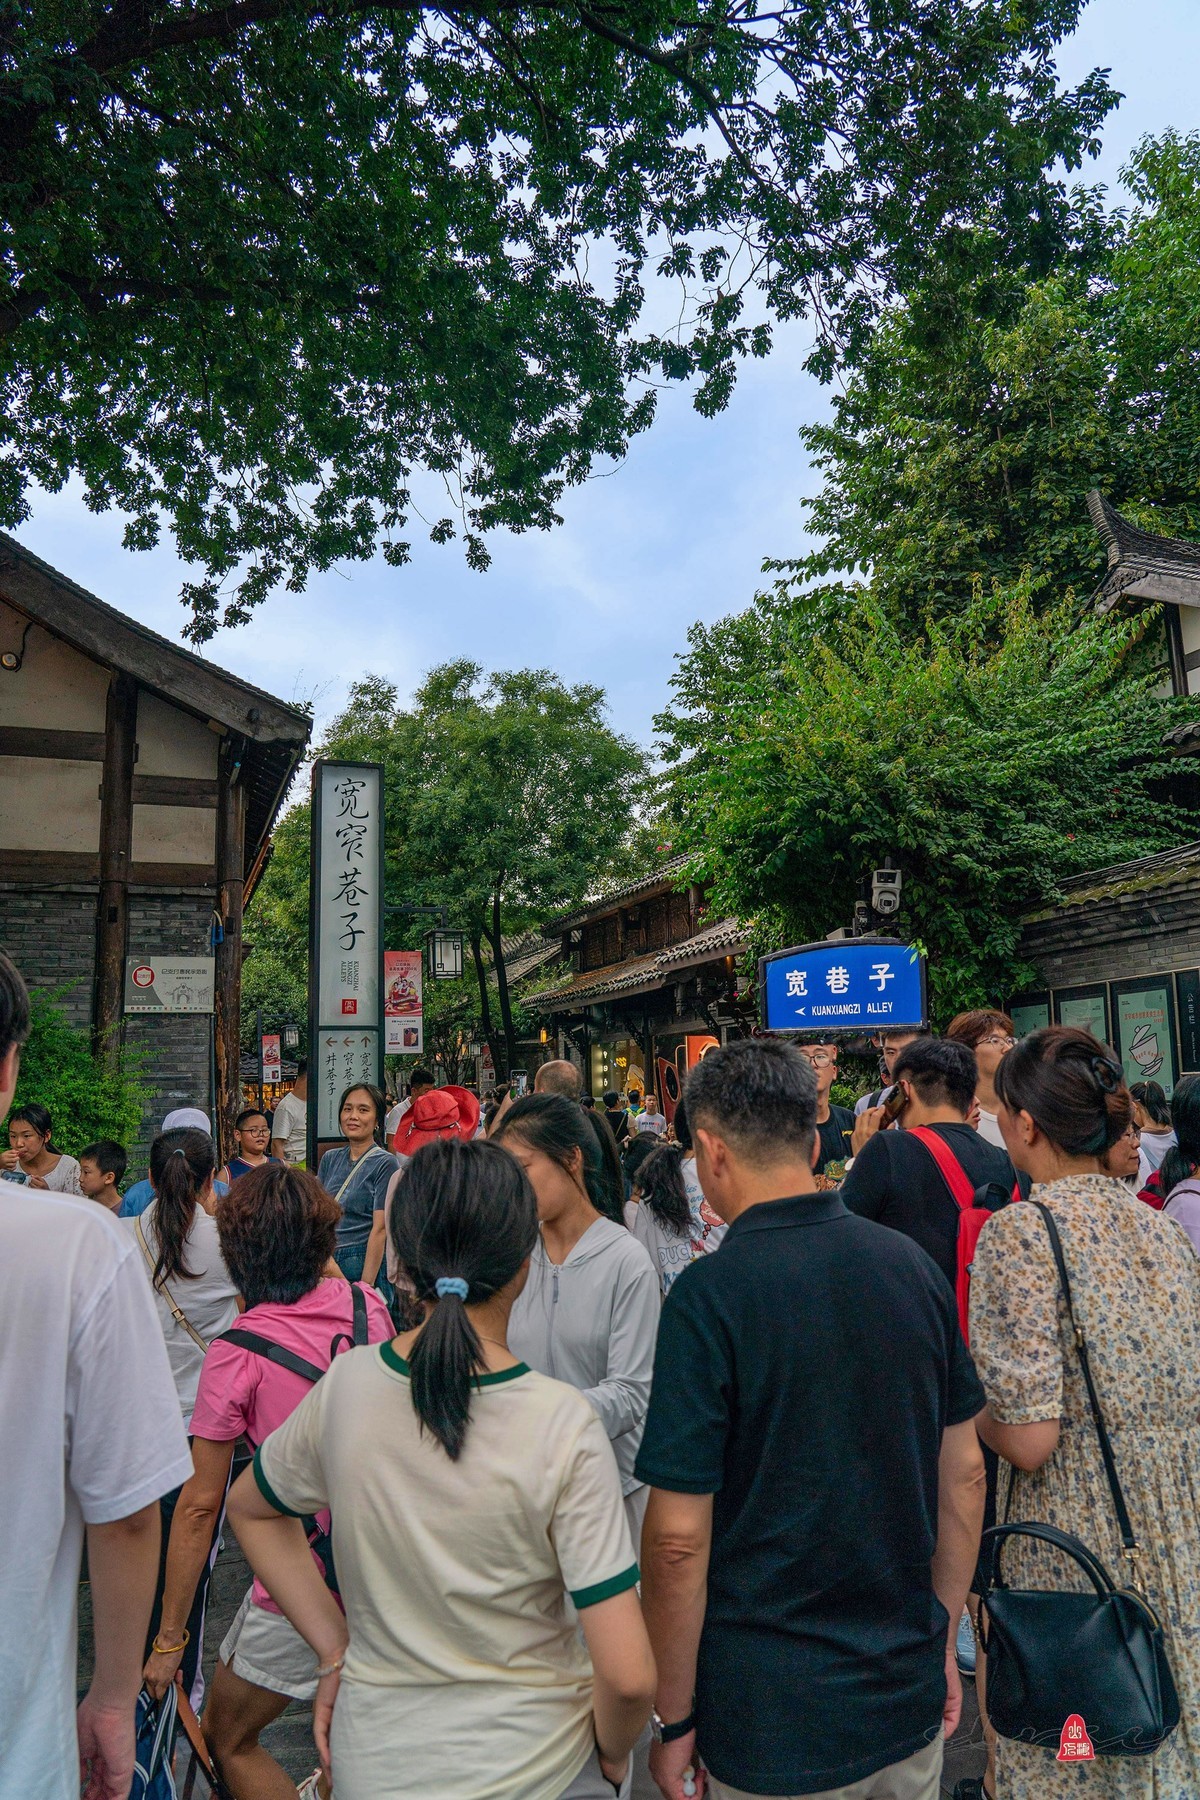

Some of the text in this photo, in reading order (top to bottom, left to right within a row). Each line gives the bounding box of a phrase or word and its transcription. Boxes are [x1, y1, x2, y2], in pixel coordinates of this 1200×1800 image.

[332, 778, 369, 951] 宽窄巷子
[785, 963, 895, 997] 宽巷子
[811, 1001, 893, 1016] KUANXIANGZI ALLEY
[325, 1052, 337, 1096] 井巷子
[360, 1052, 372, 1086] 宽巷
